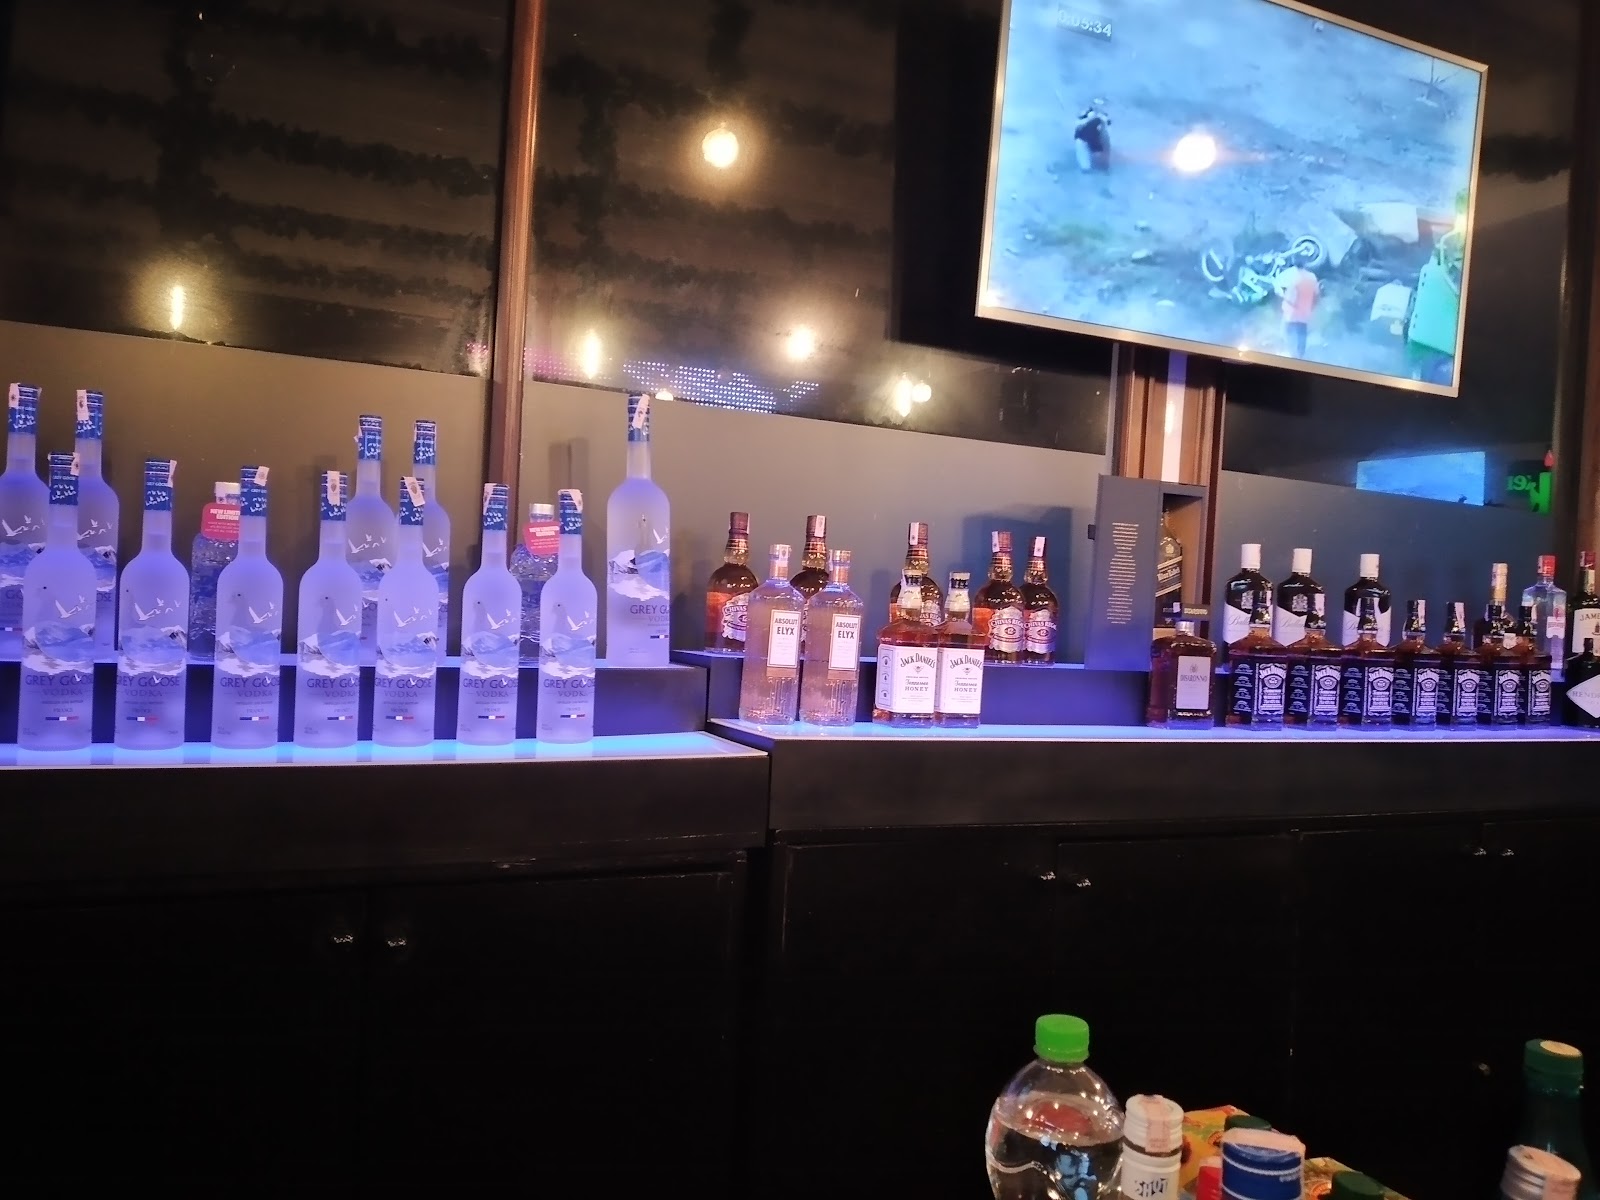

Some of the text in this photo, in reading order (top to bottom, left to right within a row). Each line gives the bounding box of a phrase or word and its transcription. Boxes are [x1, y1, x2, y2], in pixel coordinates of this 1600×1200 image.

[629, 604, 657, 615] GREY
[724, 605, 748, 614] CHIVAS
[774, 617, 798, 626] ABSOLUT
[1579, 611, 1600, 622] JAME
[990, 618, 1012, 628] CHIVAS
[776, 626, 795, 636] ELYX
[838, 630, 855, 639] ELYX
[900, 655, 915, 667] JACK
[949, 656, 965, 669] JACK
[24, 674, 54, 686] GREY
[137, 676, 181, 687] GOOSE
[220, 676, 248, 688] GREY
[306, 678, 336, 688] GREY
[396, 678, 433, 689] GOOSE
[462, 678, 486, 689] GREY
[543, 678, 568, 689] GREY
[42, 688, 83, 697] VODKA
[125, 689, 163, 697] VODKA
[237, 689, 273, 698] VODKA
[384, 690, 418, 698] VODKA
[475, 690, 510, 698] VODKA
